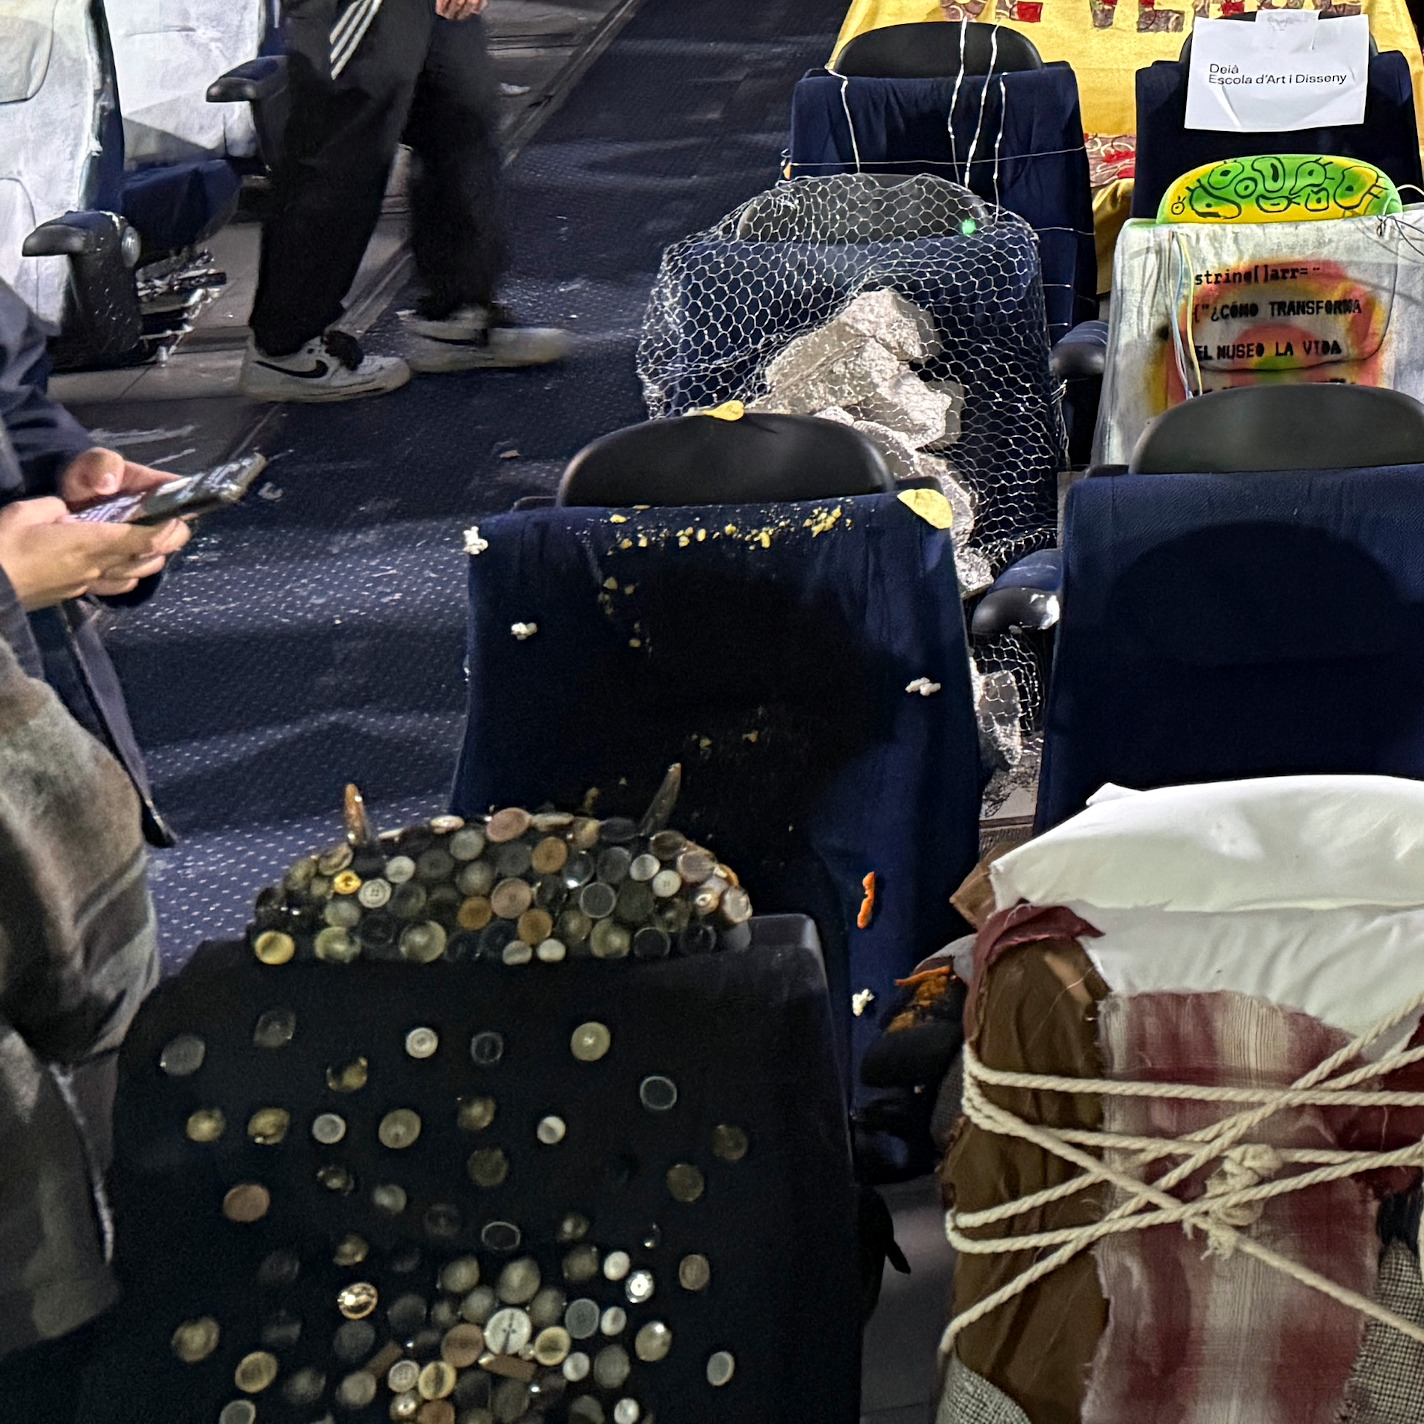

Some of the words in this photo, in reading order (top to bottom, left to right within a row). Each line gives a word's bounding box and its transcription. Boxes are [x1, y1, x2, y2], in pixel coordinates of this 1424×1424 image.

[1209, 63, 1239, 74] Deià
[1208, 74, 1252, 85] Escola
[1256, 74, 1286, 84] d'Art
[1295, 74, 1347, 85] Disseny
[1269, 298, 1362, 317] TRANSFORMA
[1217, 342, 1265, 359] MUSEO
[1275, 341, 1294, 357] LA
[1303, 340, 1342, 355] VIDA
